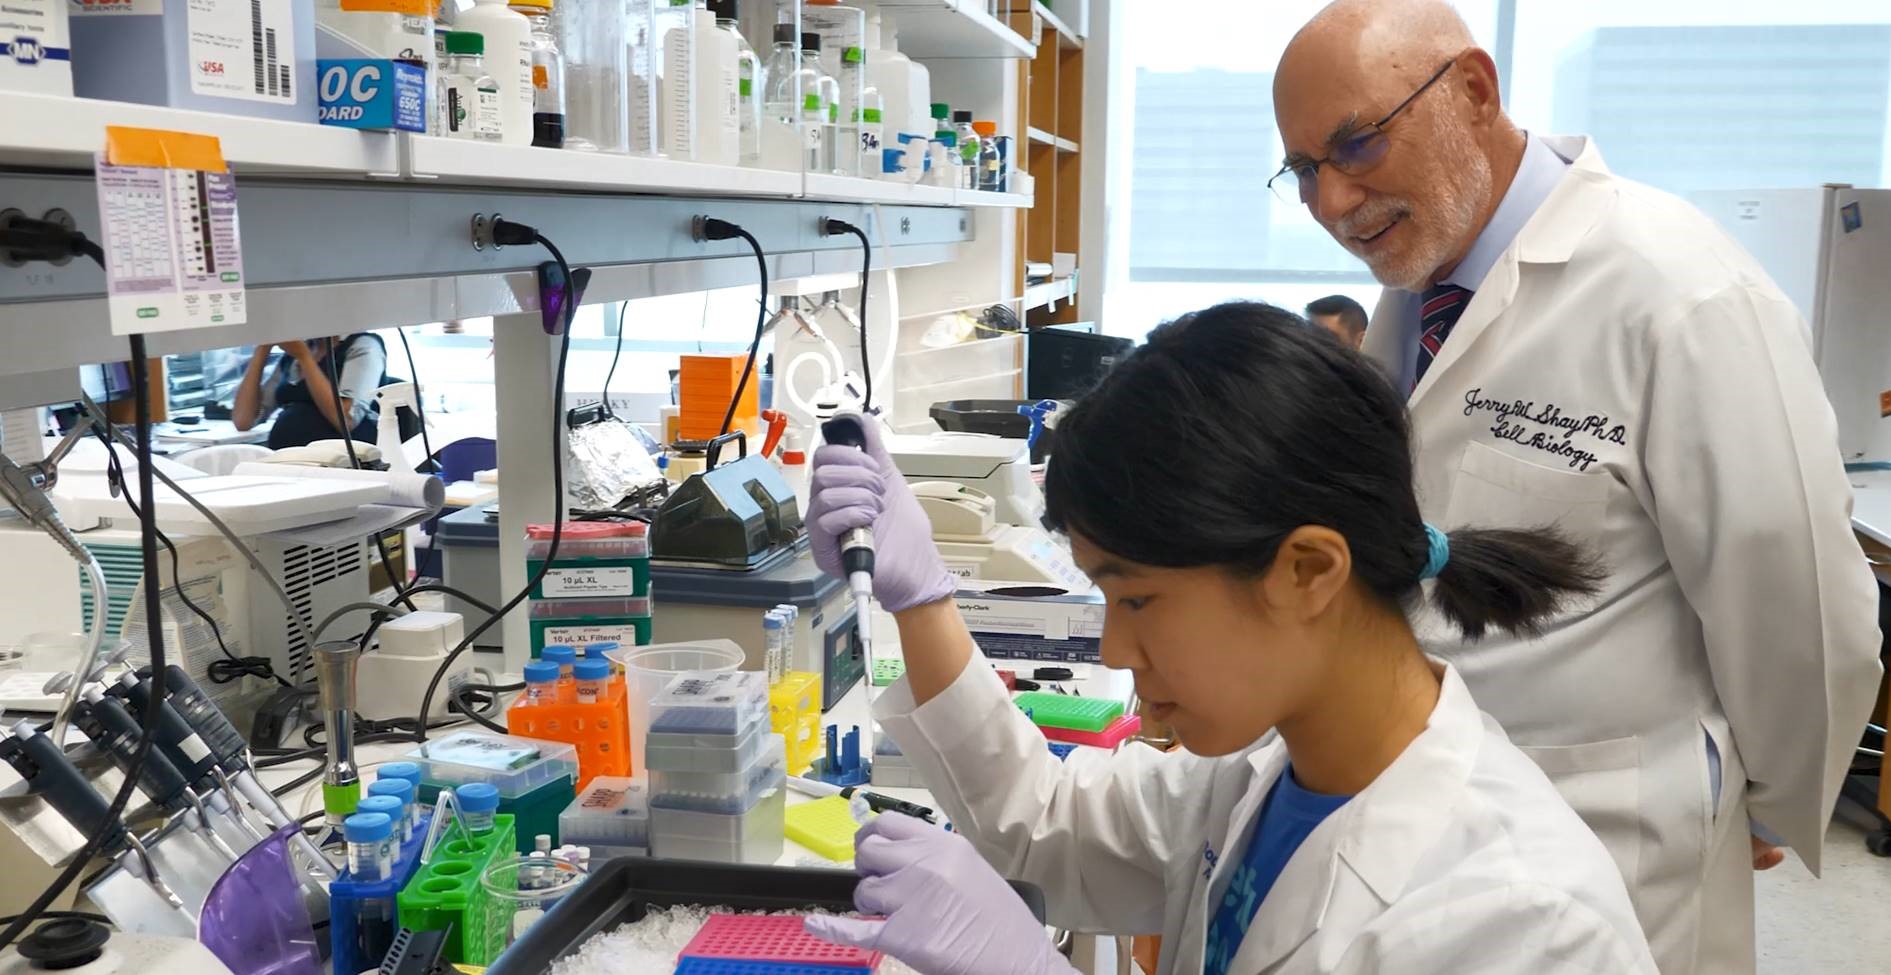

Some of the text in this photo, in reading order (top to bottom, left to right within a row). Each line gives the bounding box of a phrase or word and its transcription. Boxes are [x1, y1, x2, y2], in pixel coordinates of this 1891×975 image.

[13, 42, 40, 60] MN
[203, 61, 224, 73] USA
[1463, 388, 1511, 423] Jerry
[1490, 421, 1598, 471] Cell Biology
[586, 576, 598, 584] XL
[553, 635, 563, 643] 10
[577, 634, 588, 642] XL
[590, 633, 622, 642] Filtered
